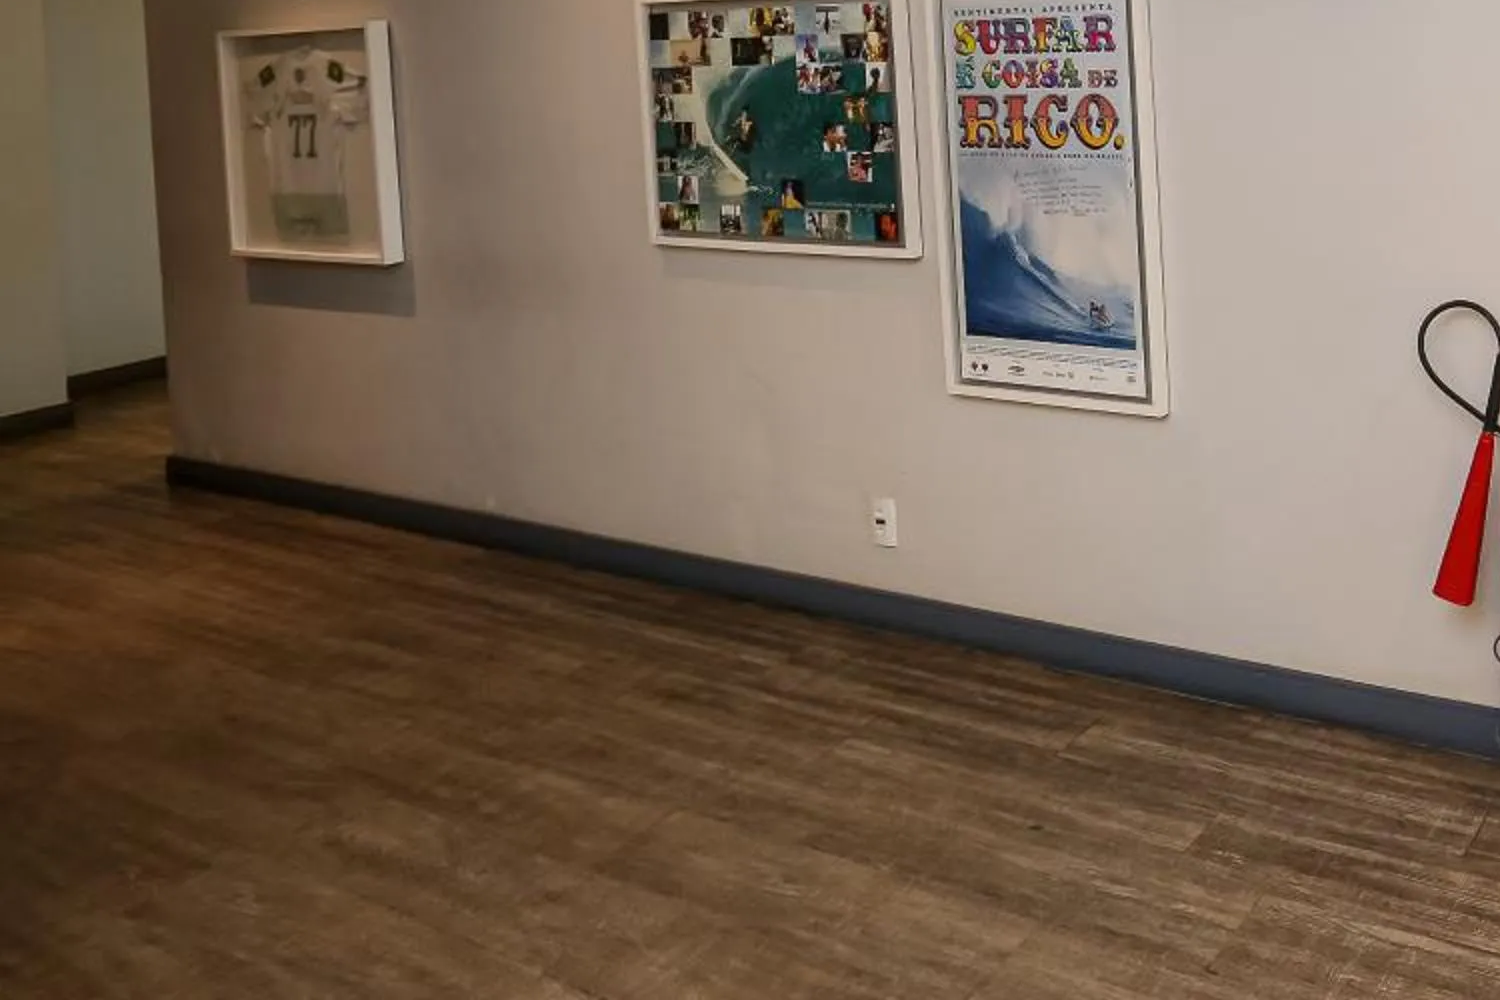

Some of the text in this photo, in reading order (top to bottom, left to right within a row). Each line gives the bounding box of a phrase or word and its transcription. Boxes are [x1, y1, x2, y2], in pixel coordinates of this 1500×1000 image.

[954, 14, 1117, 55] SURFAR
[982, 58, 1083, 89] COISA
[1087, 69, 1119, 88] DE
[288, 114, 318, 159] 77
[957, 93, 1125, 150] RICO.
